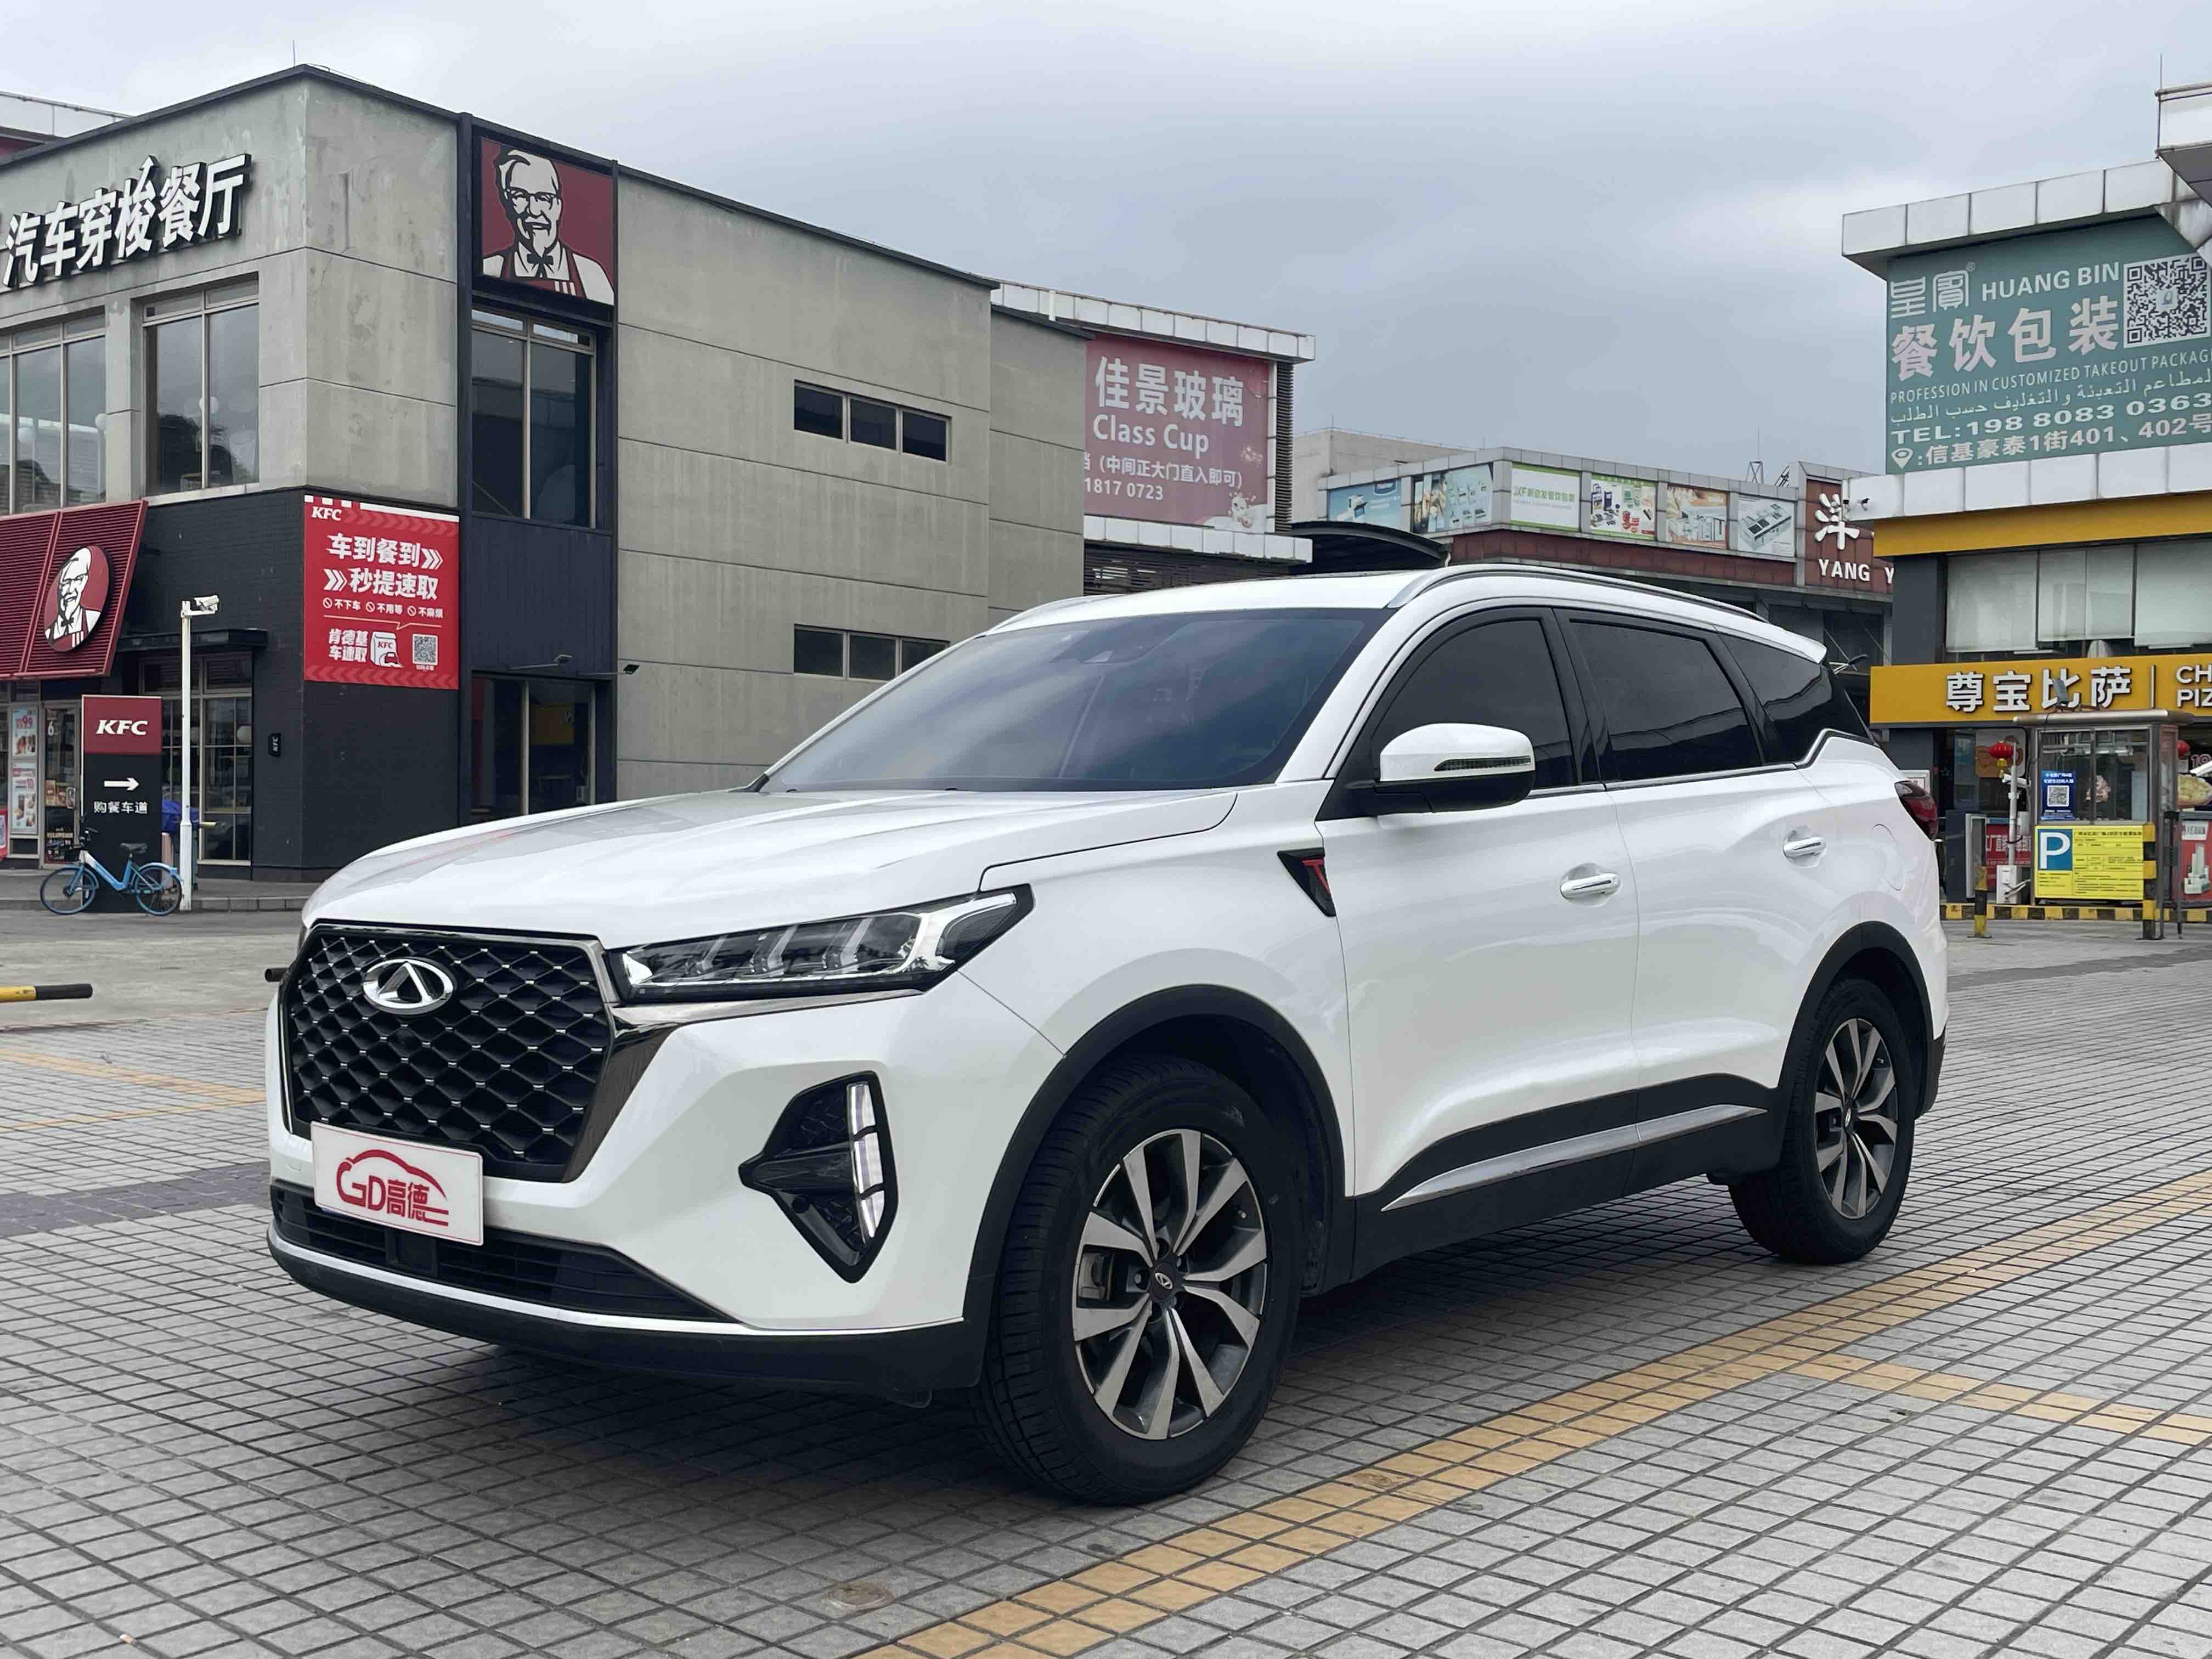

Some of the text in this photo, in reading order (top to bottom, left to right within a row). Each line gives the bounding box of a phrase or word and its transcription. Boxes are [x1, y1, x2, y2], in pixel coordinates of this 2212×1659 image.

[3, 153, 250, 287] 汽车穿梭餐厅
[1982, 262, 2119, 301] HUANG BIN
[1891, 295, 2118, 381] 餐饮包装
[1096, 356, 1244, 427] 佳景玻璃
[1891, 381, 1970, 404] PROFESSION
[1974, 379, 1988, 393] IN
[1992, 367, 2080, 391] CUSTOMIZED
[2084, 357, 2148, 378] TAKEOUT
[2033, 404, 2114, 427] 8083
[2126, 392, 2212, 416] 0363
[1093, 414, 1209, 459] Class Cup
[1084, 477, 1164, 500] 1817 0723
[312, 506, 342, 521] KFC
[326, 533, 421, 567] 车到餐到
[348, 567, 438, 600] 秒提速取
[1818, 558, 1870, 582] YANG
[334, 599, 361, 611] 不下车
[377, 603, 403, 615] 不用等
[329, 628, 369, 647] 肯德基
[1945, 666, 2132, 712] 尊宝比萨
[2176, 664, 2212, 684] CH
[2177, 688, 2212, 707] PIZ
[96, 719, 148, 736] KFC
[93, 801, 148, 815] 购餐车道
[2040, 832, 2070, 870] P
